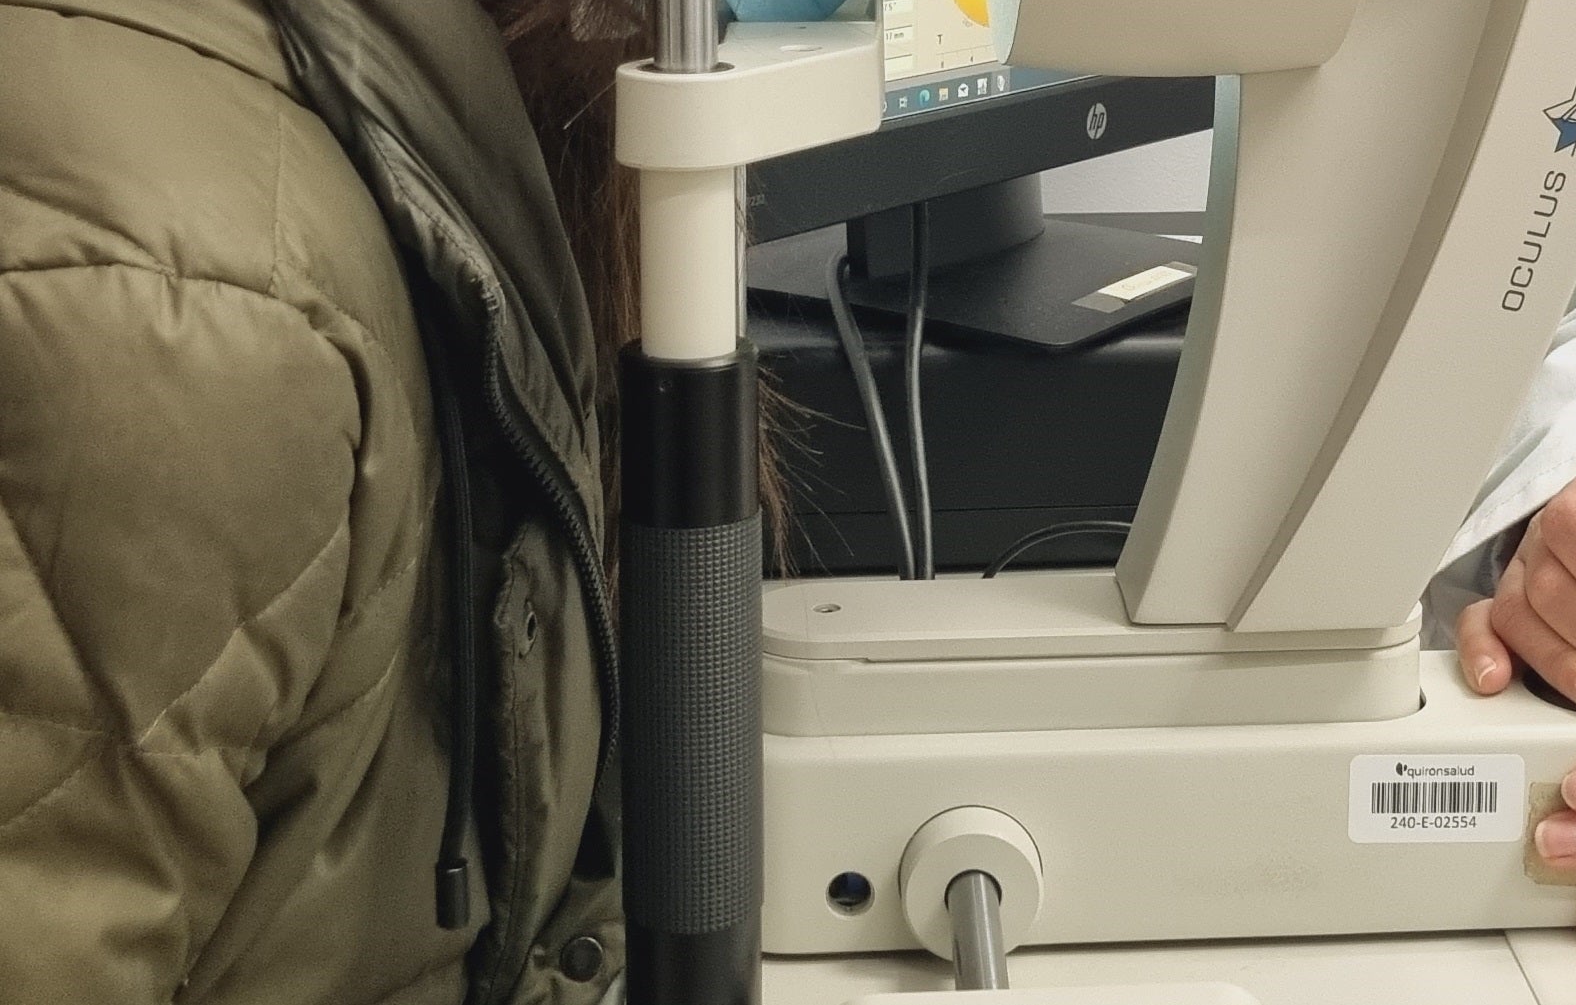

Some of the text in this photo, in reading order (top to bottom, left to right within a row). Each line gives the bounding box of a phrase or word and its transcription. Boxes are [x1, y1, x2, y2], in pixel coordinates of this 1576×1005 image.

[1087, 103, 1107, 139] hp
[1501, 169, 1568, 313] OCULUS
[1390, 816, 1478, 829] 240-E-02554
